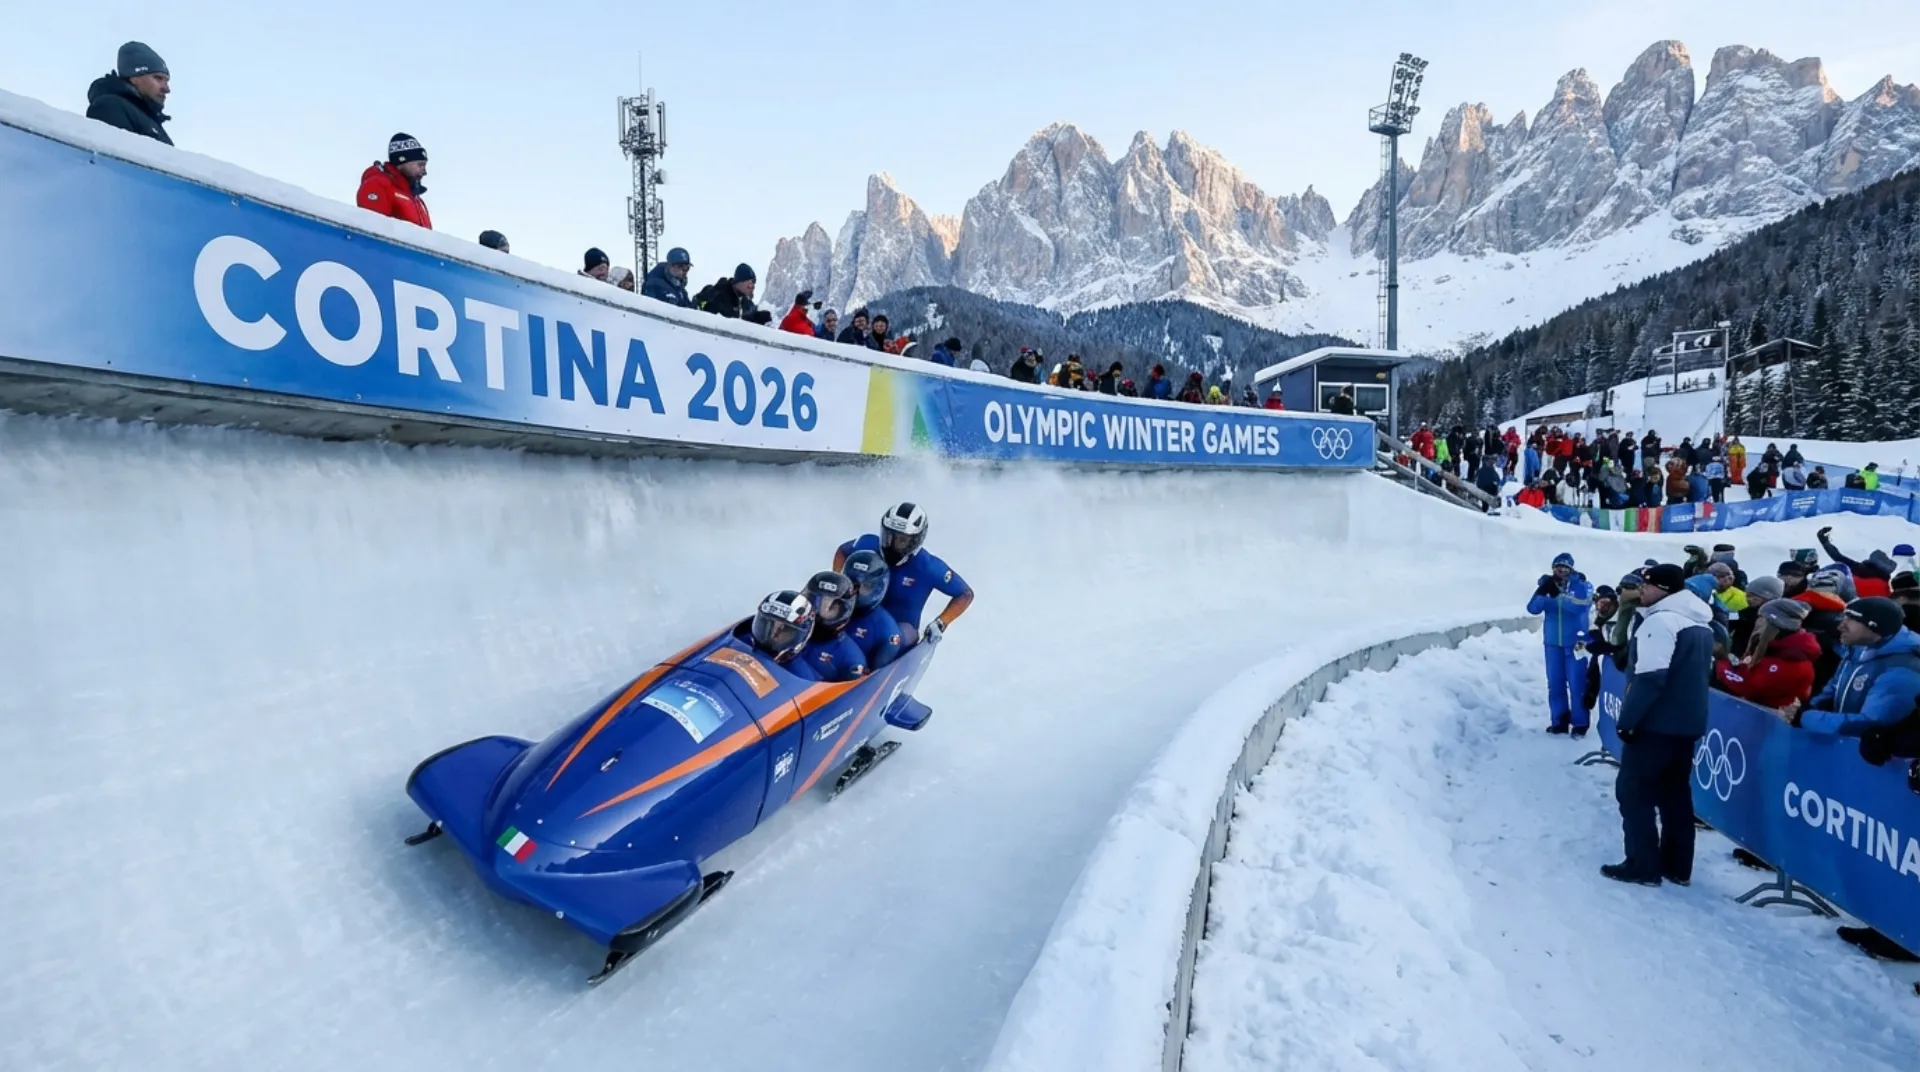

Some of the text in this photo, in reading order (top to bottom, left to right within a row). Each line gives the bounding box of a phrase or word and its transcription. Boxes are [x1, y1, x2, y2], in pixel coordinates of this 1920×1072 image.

[193, 235, 819, 432] CORTINA 2026
[984, 400, 1280, 456] OLYMPIC WINTER GAMES
[1784, 781, 1920, 883] CORTINA
